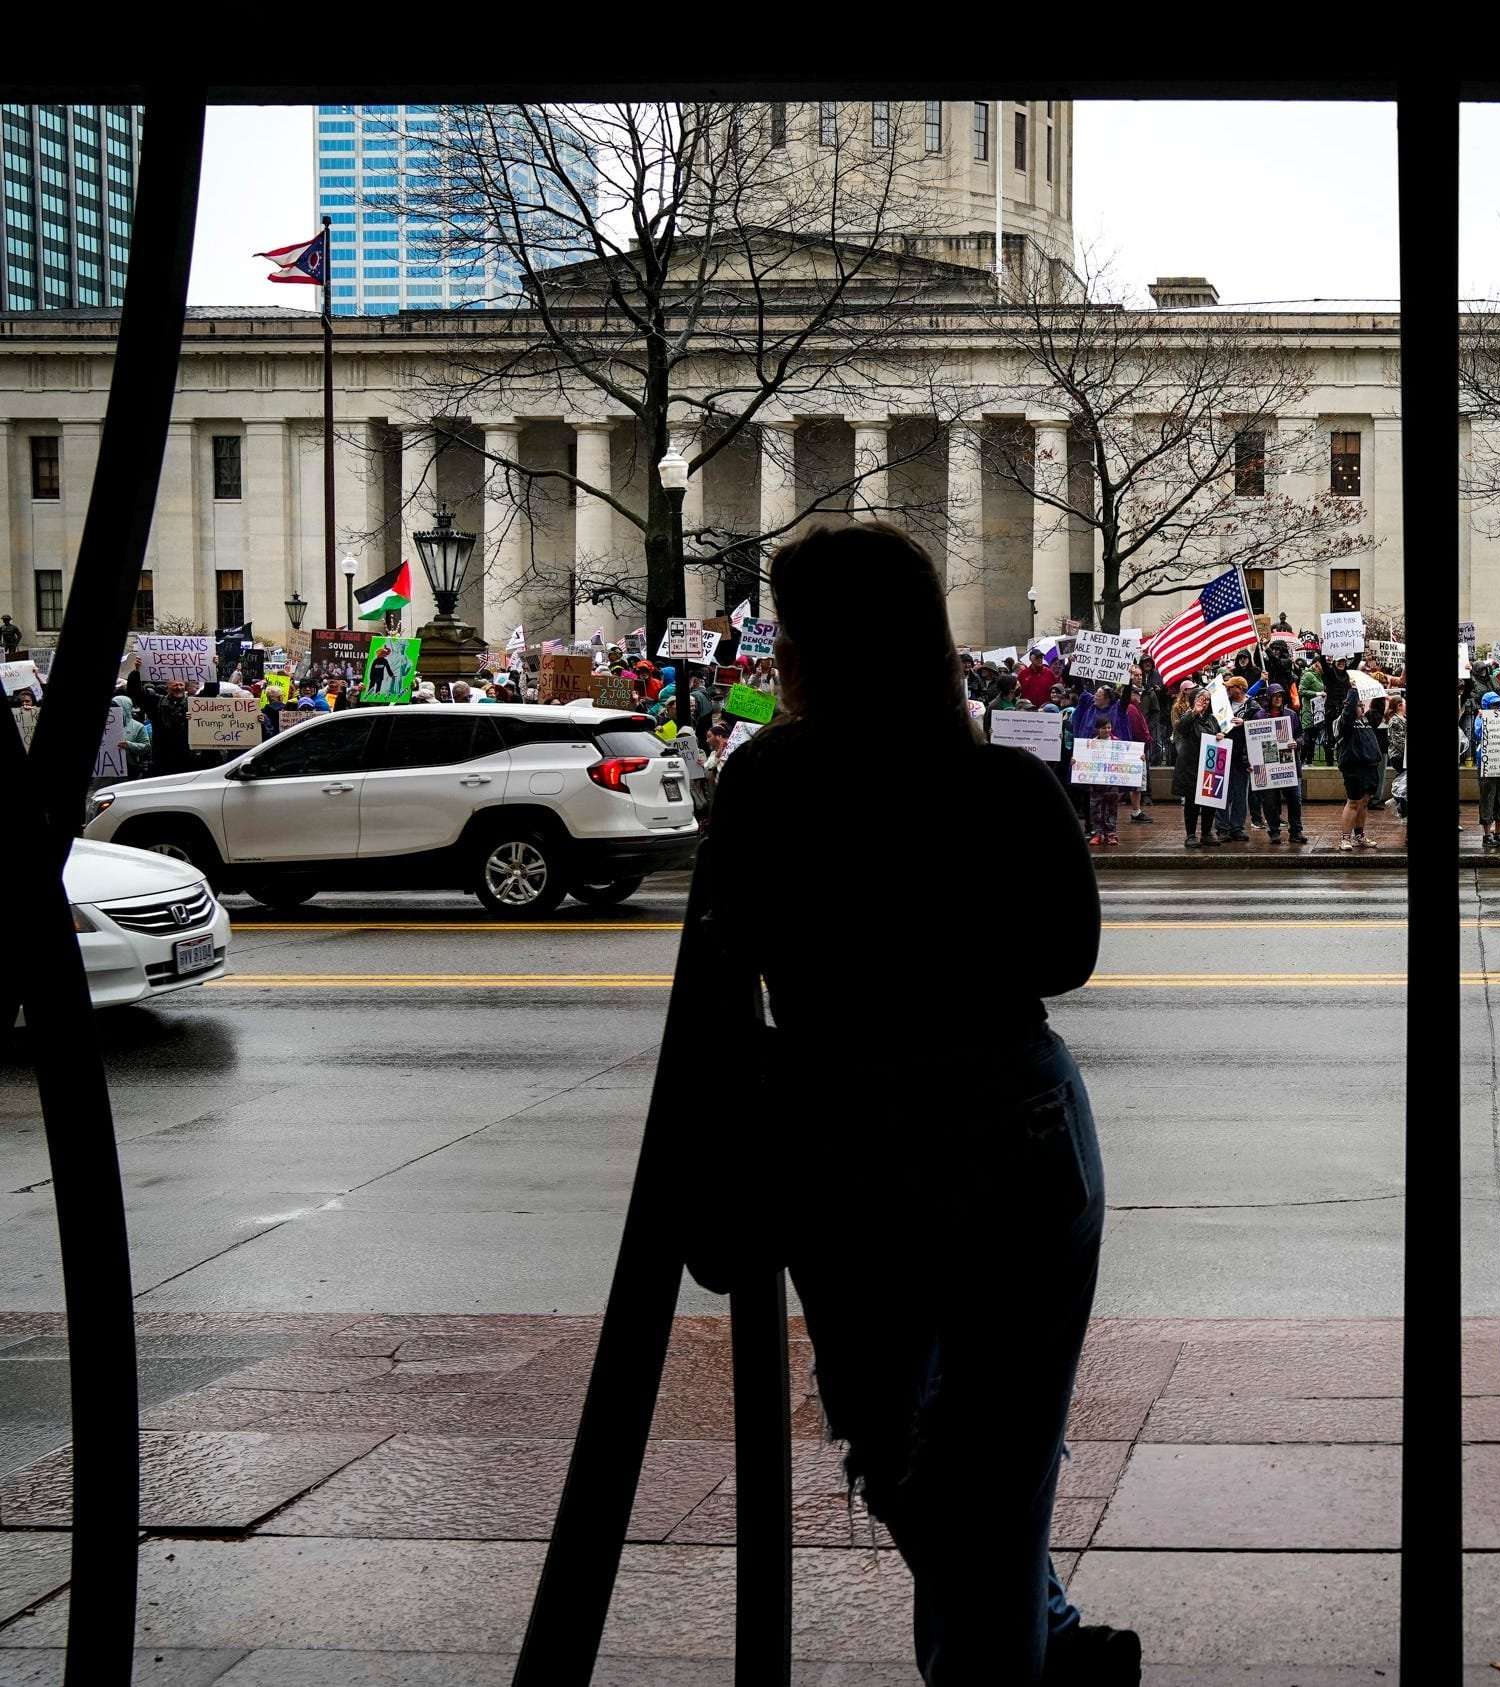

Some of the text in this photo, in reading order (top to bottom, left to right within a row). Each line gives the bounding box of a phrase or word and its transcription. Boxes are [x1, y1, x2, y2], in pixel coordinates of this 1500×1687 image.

[138, 638, 208, 651] VETERANS
[328, 642, 353, 650] SOUND
[743, 636, 773, 645] DEMOCR
[1082, 632, 1131, 648] I NEED TO BE
[1380, 642, 1398, 650] HONK
[1075, 643, 1135, 659] ABLE TO TELL MY
[153, 652, 206, 666] DESERVE
[564, 657, 573, 672] A
[1101, 659, 1115, 668] DID
[1117, 662, 1131, 671] NOT
[149, 666, 211, 681] BETTER!
[1077, 667, 1124, 682] STAY SILENT
[542, 673, 581, 690] SPINE
[607, 678, 632, 689] LOST
[600, 689, 631, 699] 2 JOBS
[192, 700, 257, 713] Soldiers DIE
[194, 719, 255, 729] Trump Plays
[213, 731, 242, 742] Golf
[1206, 747, 1226, 771] 86
[1203, 771, 1224, 796] 47
